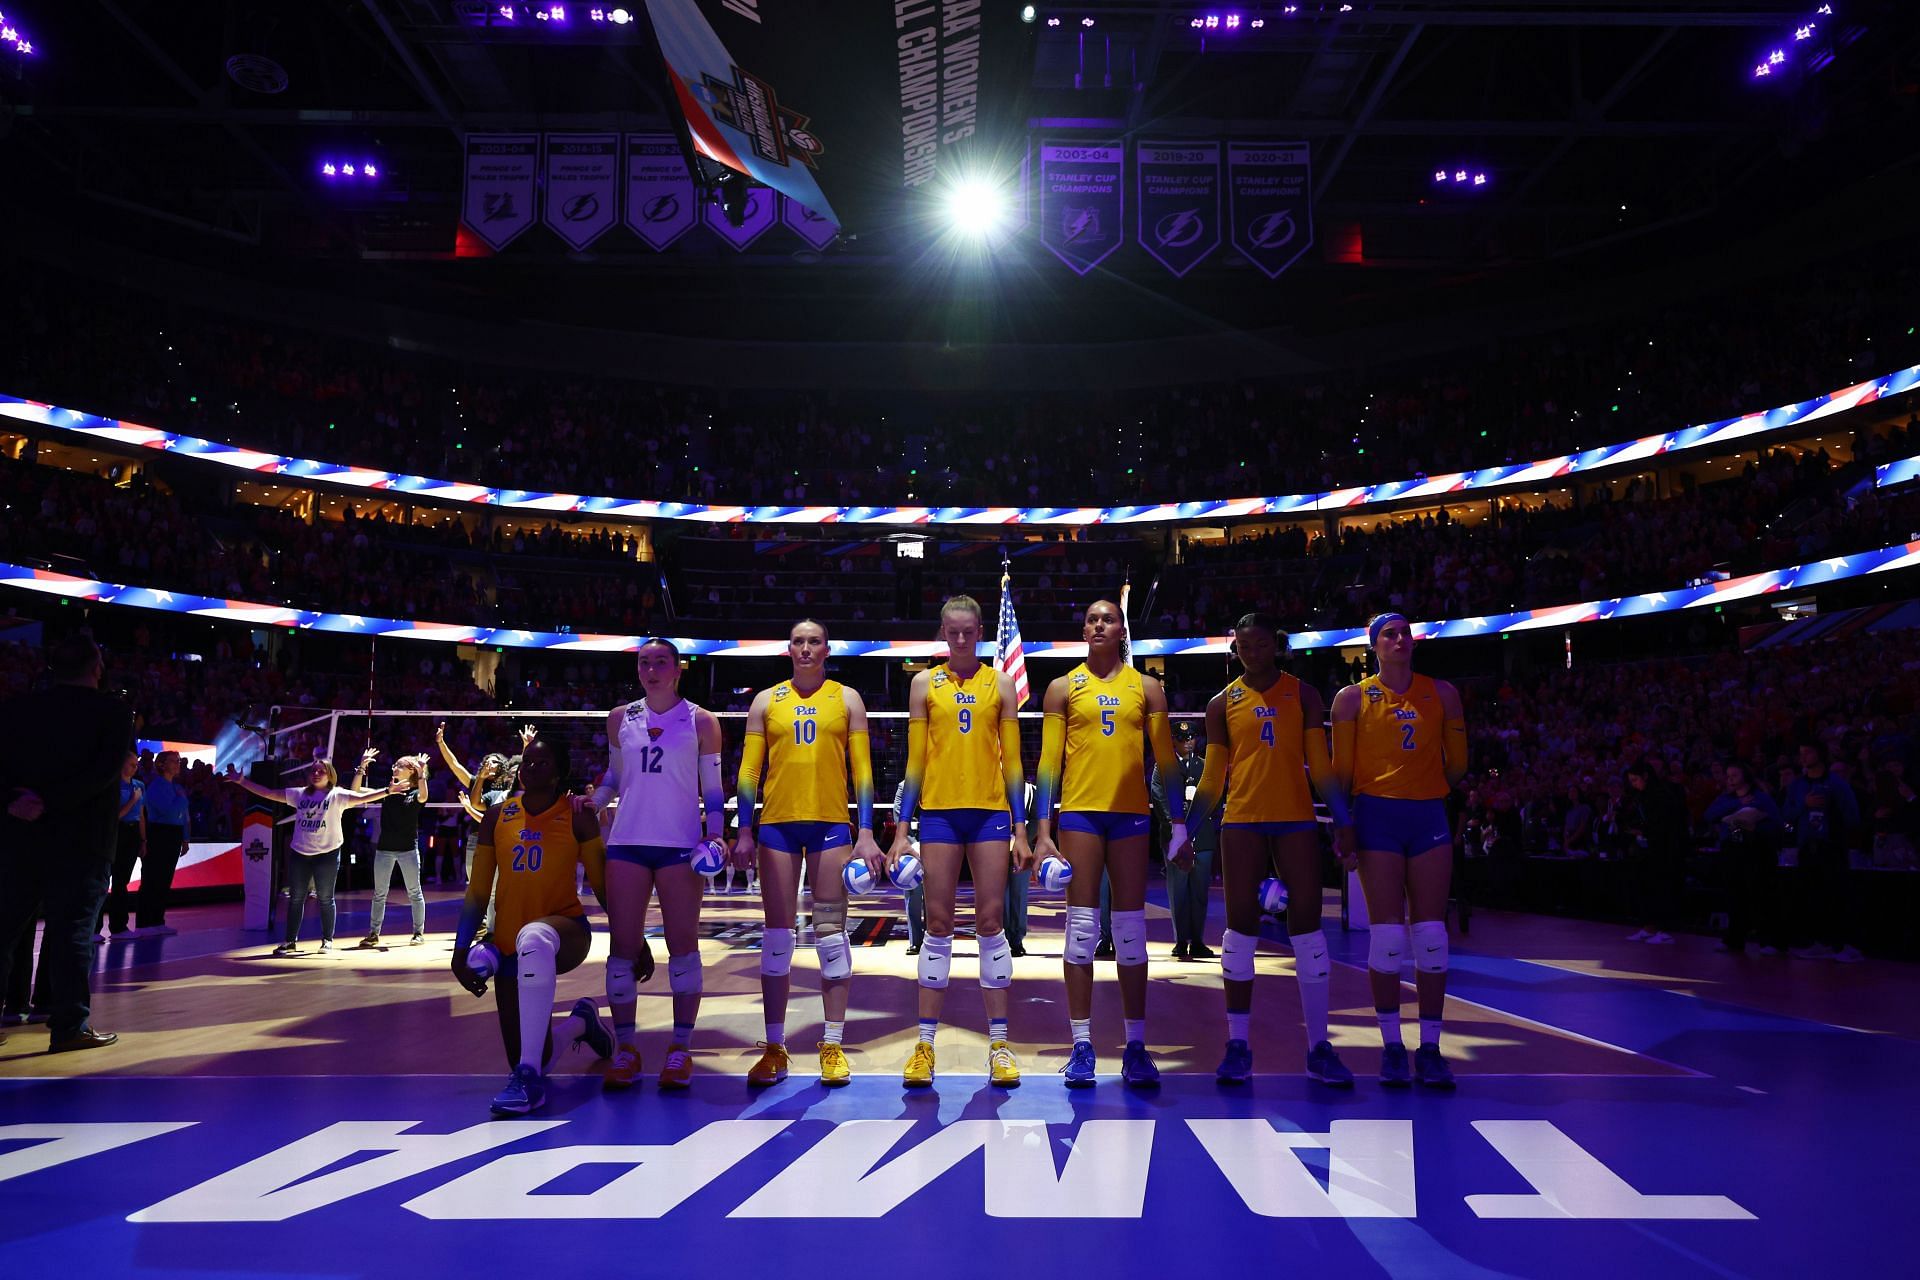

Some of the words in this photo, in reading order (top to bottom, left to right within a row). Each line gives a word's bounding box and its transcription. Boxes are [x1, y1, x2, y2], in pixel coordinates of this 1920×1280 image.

[895, 0, 935, 28] LL
[943, 0, 981, 37] AA
[943, 34, 981, 145] WOMEN'S
[897, 26, 937, 187] CHAMPIONSHIP
[1055, 150, 1109, 160] 2003-04
[1153, 151, 1204, 161] 2019-20
[1244, 152, 1295, 162] 2020-21
[1048, 173, 1092, 182] STANLEY
[1095, 173, 1117, 182] CUP
[1145, 175, 1189, 184] STANLEY
[1191, 175, 1214, 184] CUP
[1235, 176, 1280, 185] STANLEY
[1281, 176, 1304, 185] CUP
[1051, 184, 1113, 193] CHAMPIONS
[1148, 185, 1210, 195] CHAMPIONS
[1240, 187, 1302, 196] CHAMPIONS
[953, 692, 977, 704] Pitt
[1095, 694, 1121, 706] Pitt
[793, 705, 817, 716] Pitt
[1252, 706, 1278, 718] Pitt
[1392, 708, 1417, 721] Pitt
[958, 708, 972, 735] 9
[1101, 710, 1116, 736] 5
[793, 719, 817, 745] 10
[1260, 720, 1275, 749] 4
[1401, 723, 1416, 751] 2
[640, 746, 664, 773] 12
[298, 799, 329, 810] SOUTH
[298, 818, 327, 829] ORIDA
[518, 829, 543, 841] Pitt
[512, 844, 543, 872] 20
[126, 1119, 1759, 1222] TAMPA
